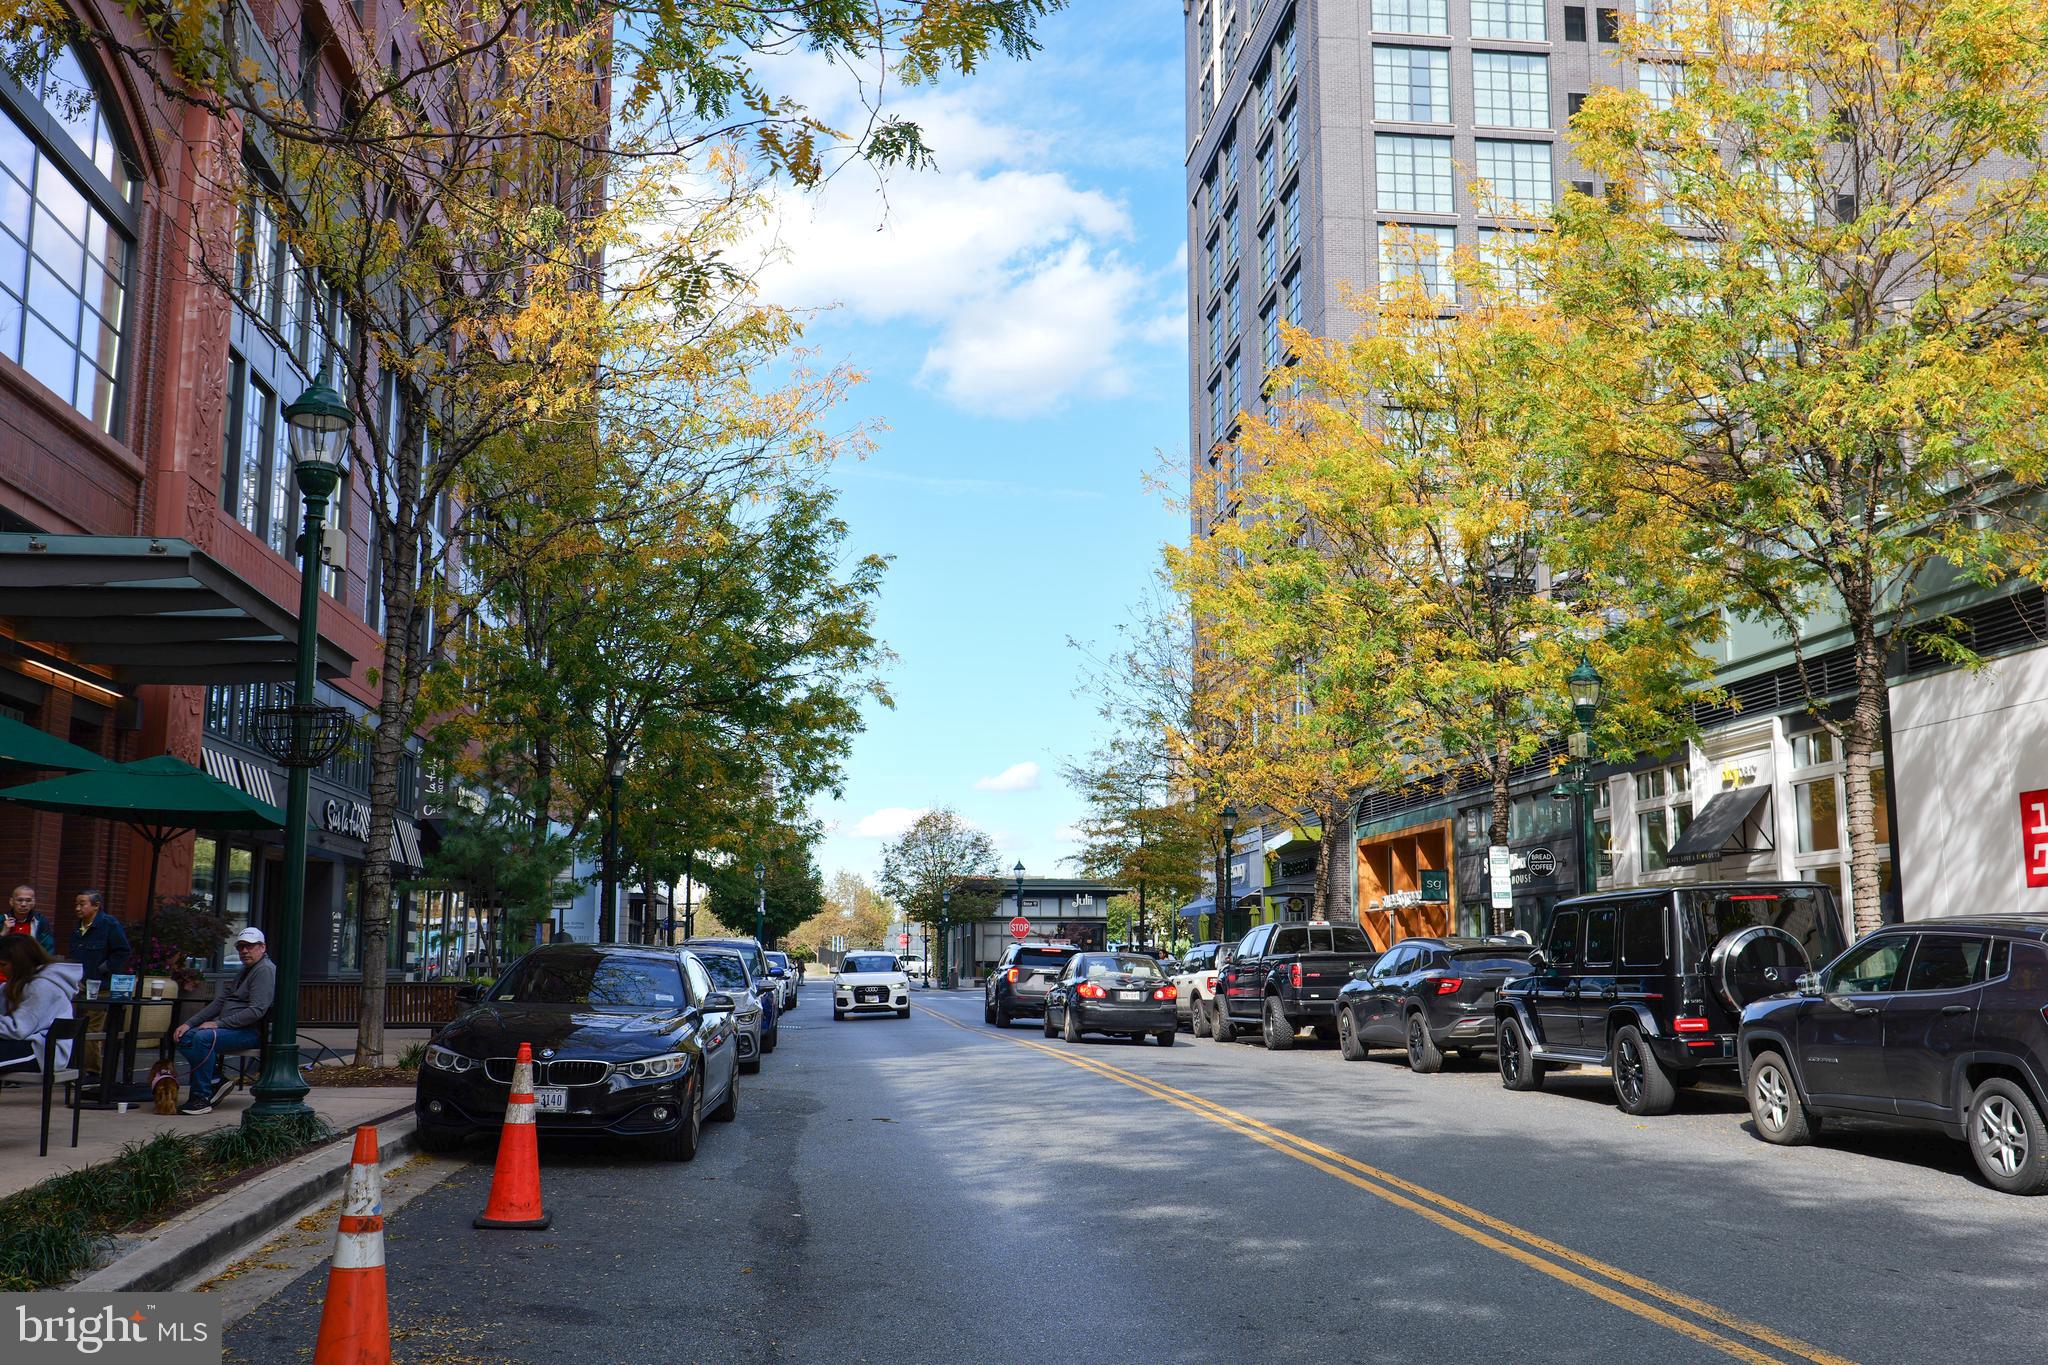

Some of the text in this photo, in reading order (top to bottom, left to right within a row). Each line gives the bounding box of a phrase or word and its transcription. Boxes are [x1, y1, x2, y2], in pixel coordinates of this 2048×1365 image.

[1531, 863, 1552, 871] COFFEE
[1426, 879, 1441, 890] sg
[1511, 874, 1531, 885] HOUSE
[1011, 923, 1029, 932] STOP
[541, 1094, 562, 1107] 3140
